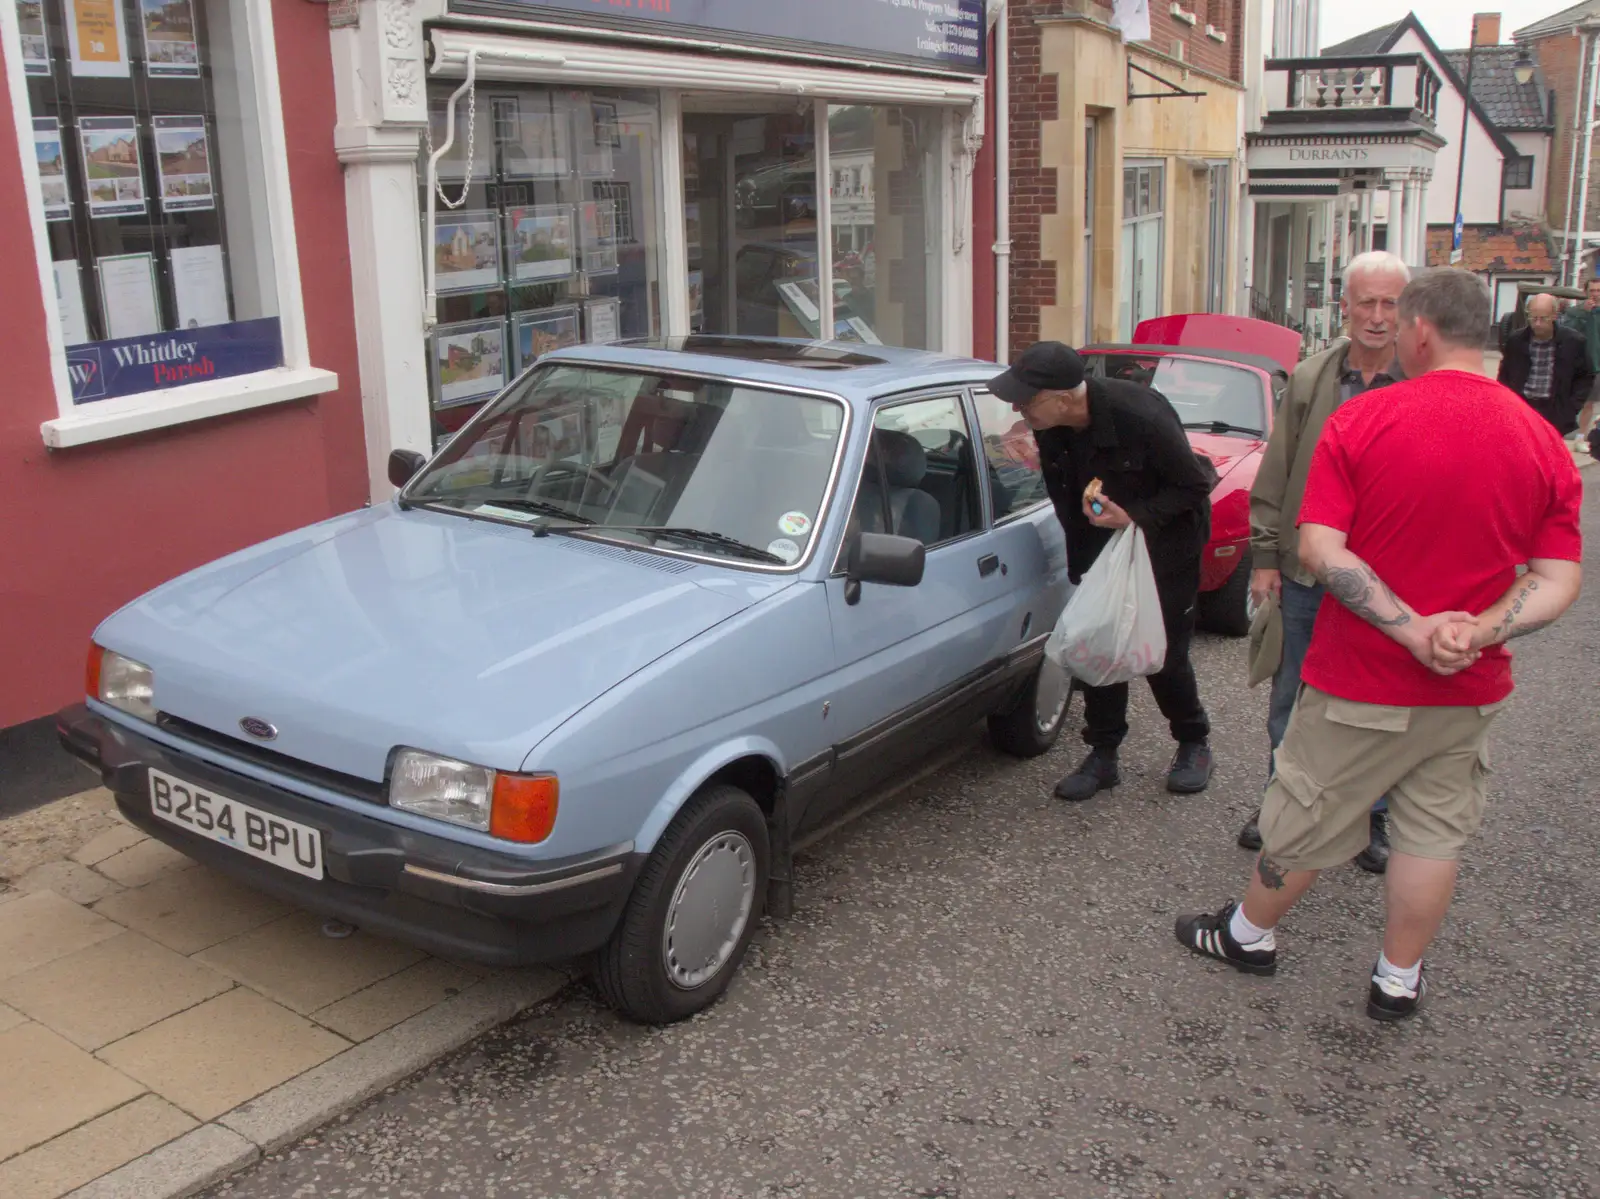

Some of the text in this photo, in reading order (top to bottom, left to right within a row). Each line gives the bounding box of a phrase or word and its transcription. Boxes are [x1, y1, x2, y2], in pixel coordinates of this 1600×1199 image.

[1289, 148, 1369, 161] DURRANTS
[112, 339, 198, 367] Whittley
[153, 356, 215, 384] Parish
[153, 775, 316, 869] B254 BPU
